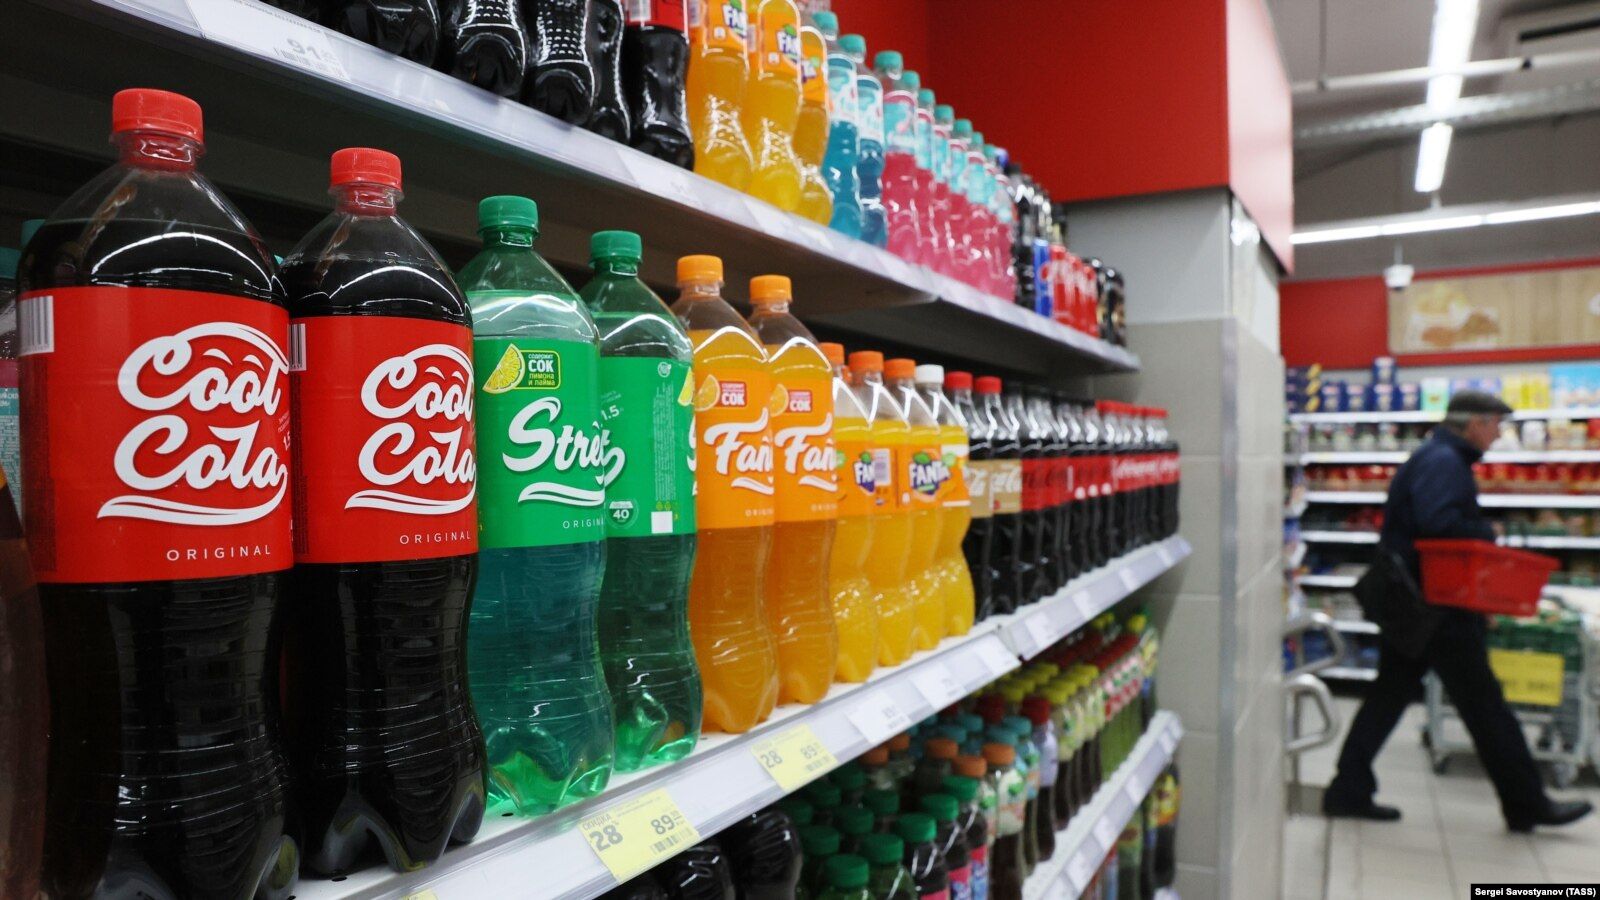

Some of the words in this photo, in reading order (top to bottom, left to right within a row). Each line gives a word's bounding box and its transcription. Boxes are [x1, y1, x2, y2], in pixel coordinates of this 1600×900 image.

[117, 321, 290, 416] Cool
[528, 360, 555, 373] СОК
[361, 343, 475, 421] Cool
[113, 413, 288, 491] Cola
[358, 422, 477, 486] Cola
[612, 509, 630, 519] 40
[399, 532, 472, 545] ORIGINAL
[166, 546, 272, 562] ORIGINAL
[760, 750, 783, 769] 28
[650, 814, 676, 835] 89
[589, 824, 624, 852] 28
